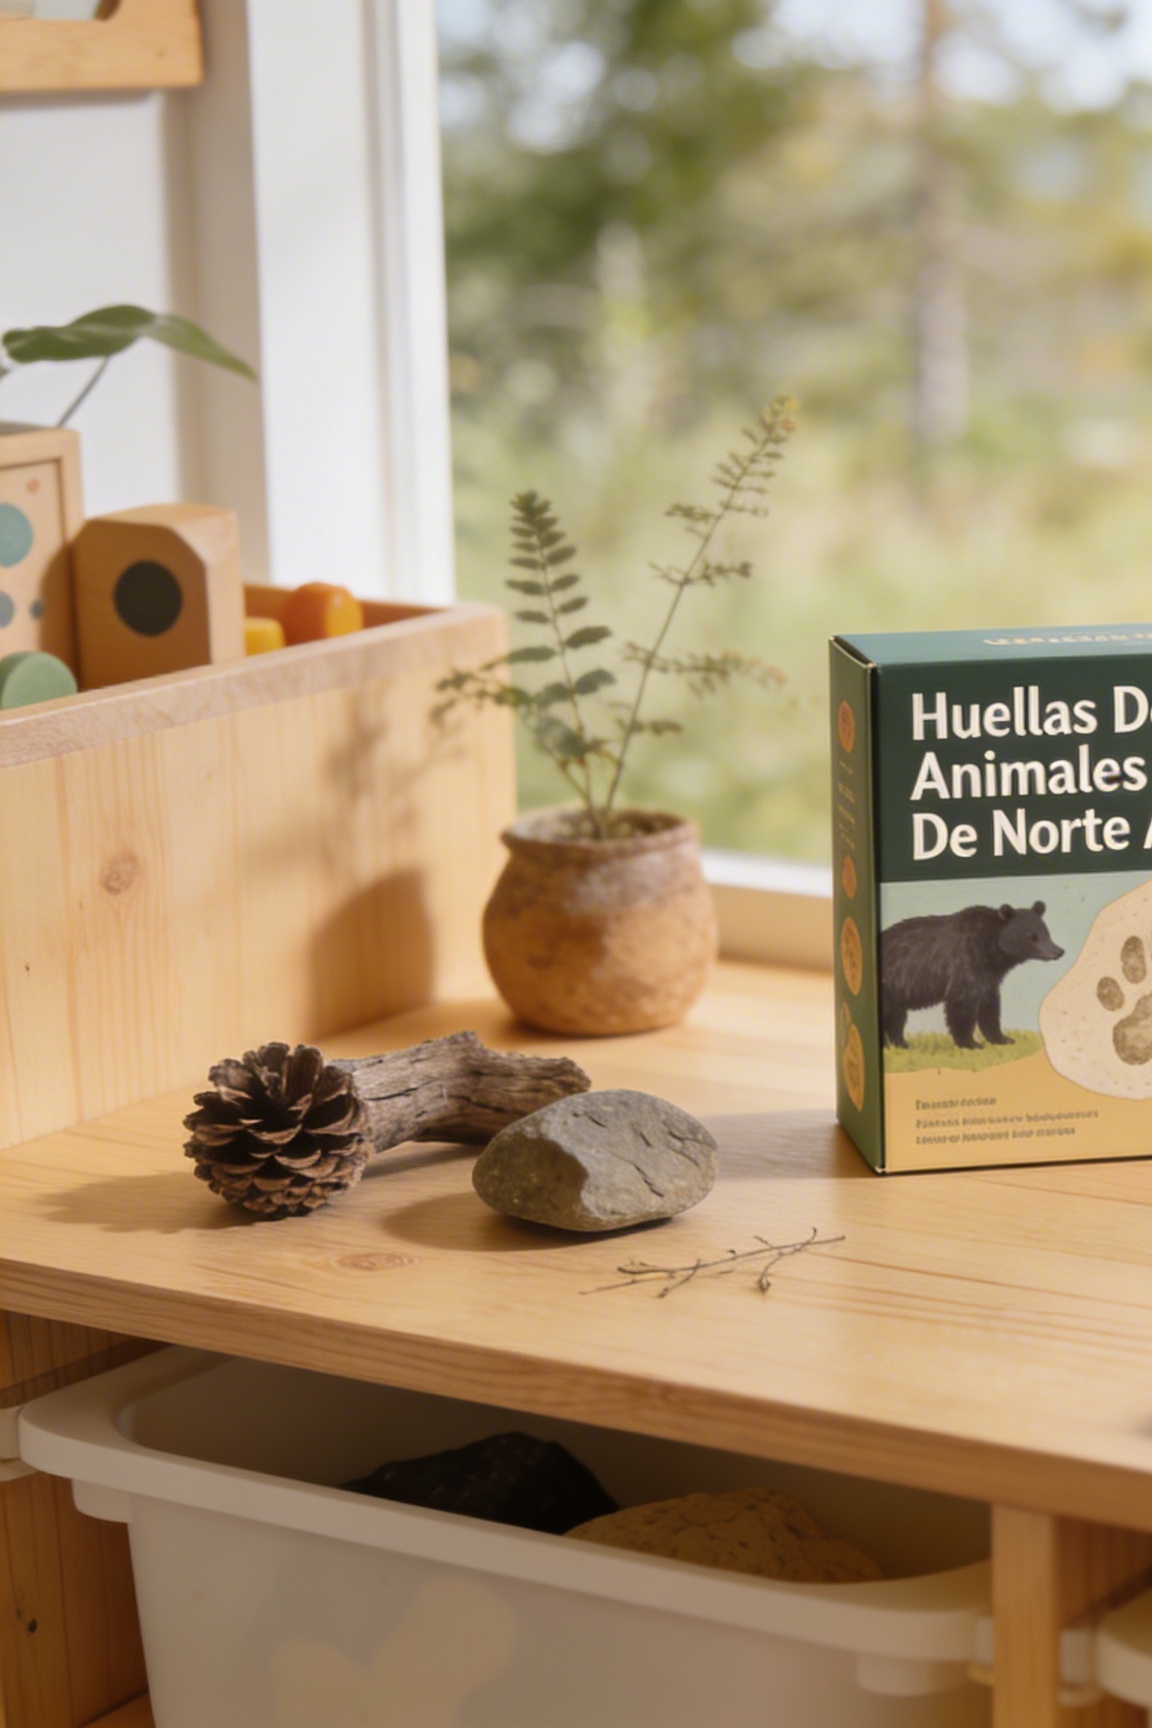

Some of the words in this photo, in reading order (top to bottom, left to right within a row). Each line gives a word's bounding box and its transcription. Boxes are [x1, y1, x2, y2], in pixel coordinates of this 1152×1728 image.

[911, 685, 1099, 742] Huellas
[909, 743, 1149, 802] Animales
[911, 812, 979, 862] De
[991, 807, 1132, 858] Norte
